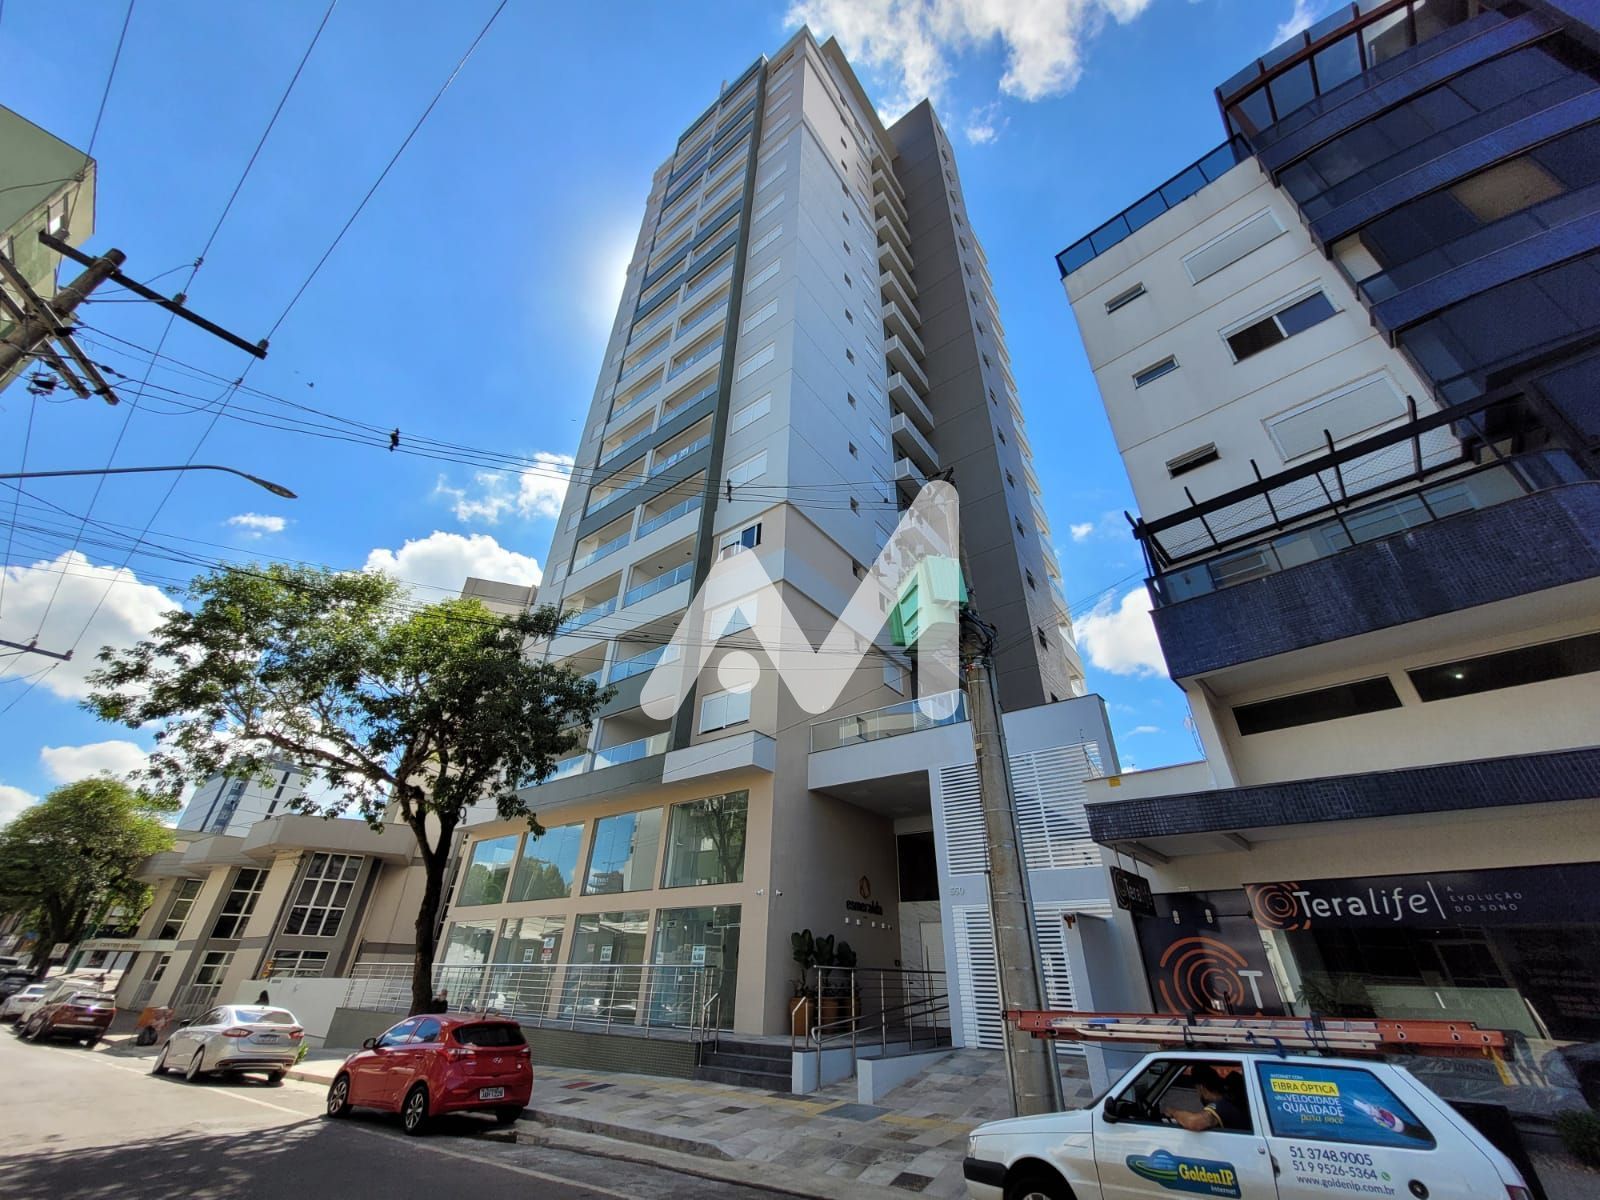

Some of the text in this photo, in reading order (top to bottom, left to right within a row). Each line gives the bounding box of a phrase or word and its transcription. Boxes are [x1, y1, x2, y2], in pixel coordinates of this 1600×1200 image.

[1292, 887, 1428, 921] Teralife
[1454, 903, 1518, 913] DO SONO
[1238, 970, 1263, 1009] T
[1272, 1081, 1336, 1094] FIBRA ÓPTICA
[1282, 1102, 1344, 1117] QUALIDADE
[1285, 1093, 1341, 1106] VELOCIDADE
[1289, 1145, 1373, 1166] 51 3748.9005
[1293, 1160, 1378, 1180] 51 9 9526-5364
[1296, 1175, 1395, 1195] www.goldenip.com.br
